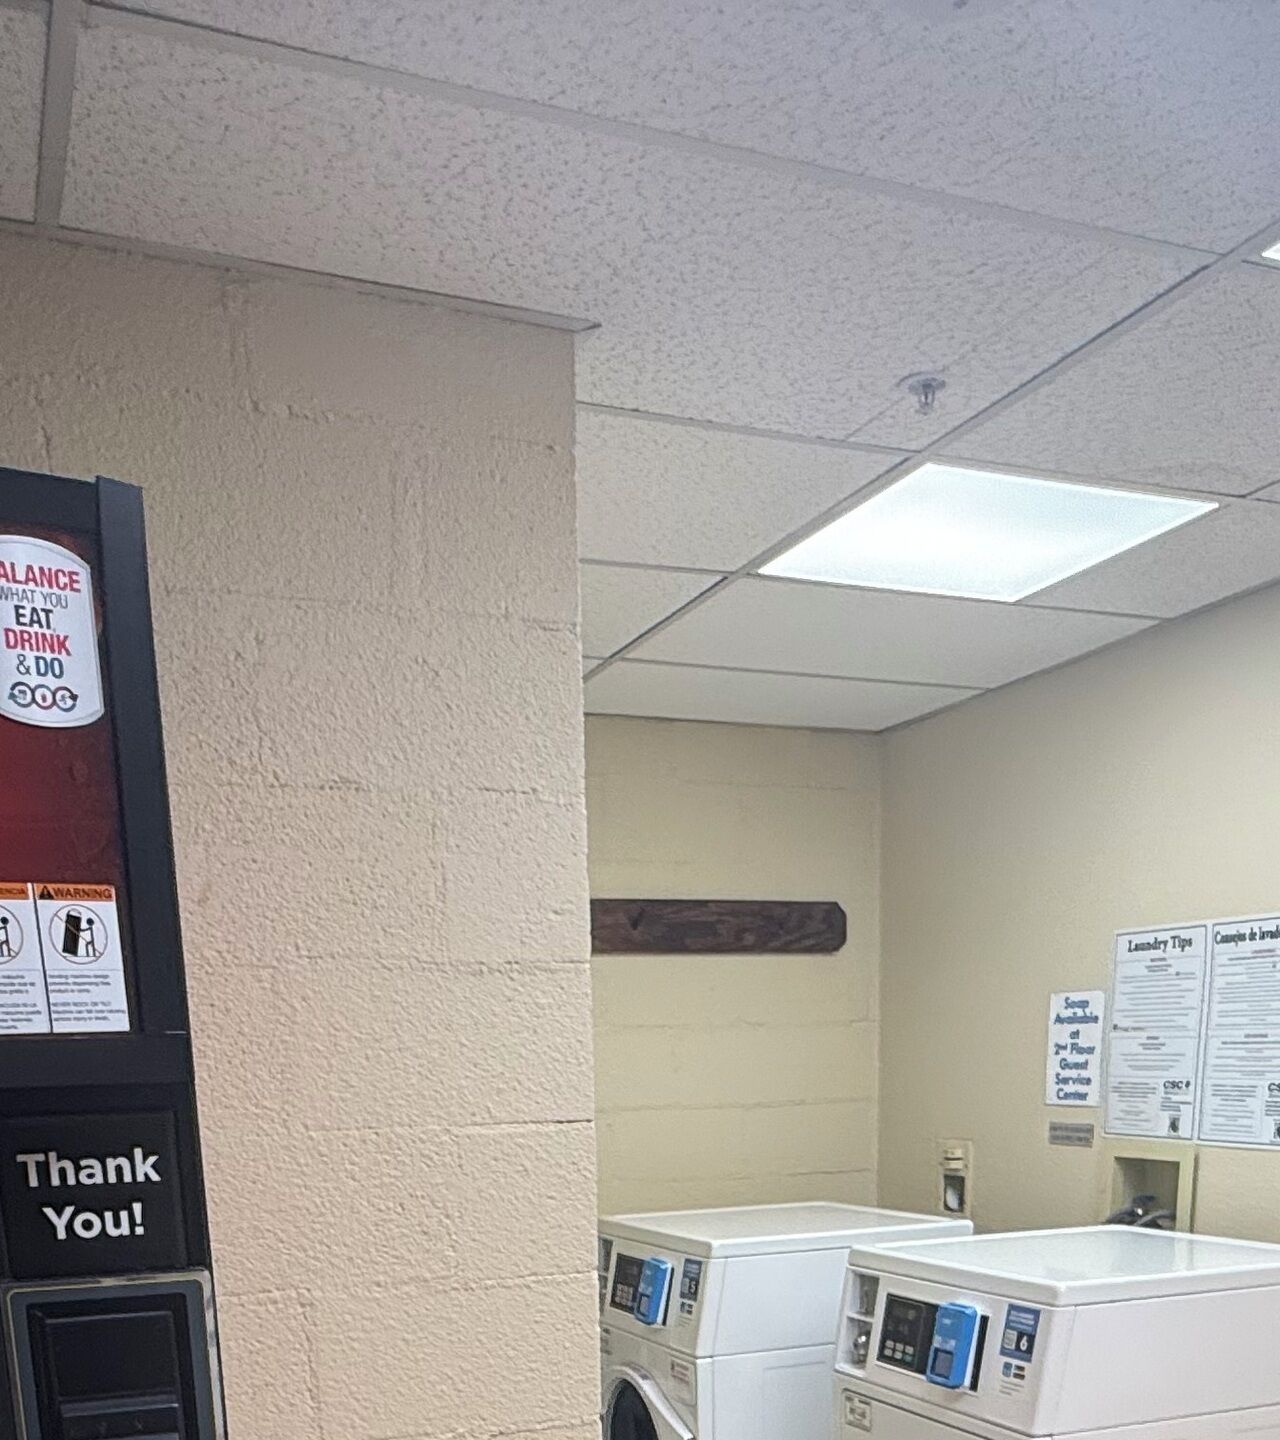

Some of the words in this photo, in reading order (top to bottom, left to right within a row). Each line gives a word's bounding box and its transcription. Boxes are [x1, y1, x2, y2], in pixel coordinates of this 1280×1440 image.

[41, 591, 69, 609] YOU
[4, 628, 71, 656] DRINK
[17, 654, 31, 676] &
[35, 656, 63, 679] DO
[53, 887, 112, 899] WARNING
[1249, 929, 1258, 942] de
[1128, 937, 1168, 953] Laundry
[1170, 936, 1193, 951] Tips
[1064, 997, 1089, 1011] Soap
[1054, 1012, 1099, 1026] Available
[1070, 1043, 1095, 1055] Floor
[1059, 1058, 1088, 1071] Guest
[1055, 1073, 1092, 1086] Service
[1163, 1080, 1183, 1090] CSC
[1057, 1088, 1088, 1101] Center
[16, 1148, 161, 1188] Thank
[42, 1203, 144, 1240] You!
[1020, 1335, 1028, 1351] 6
